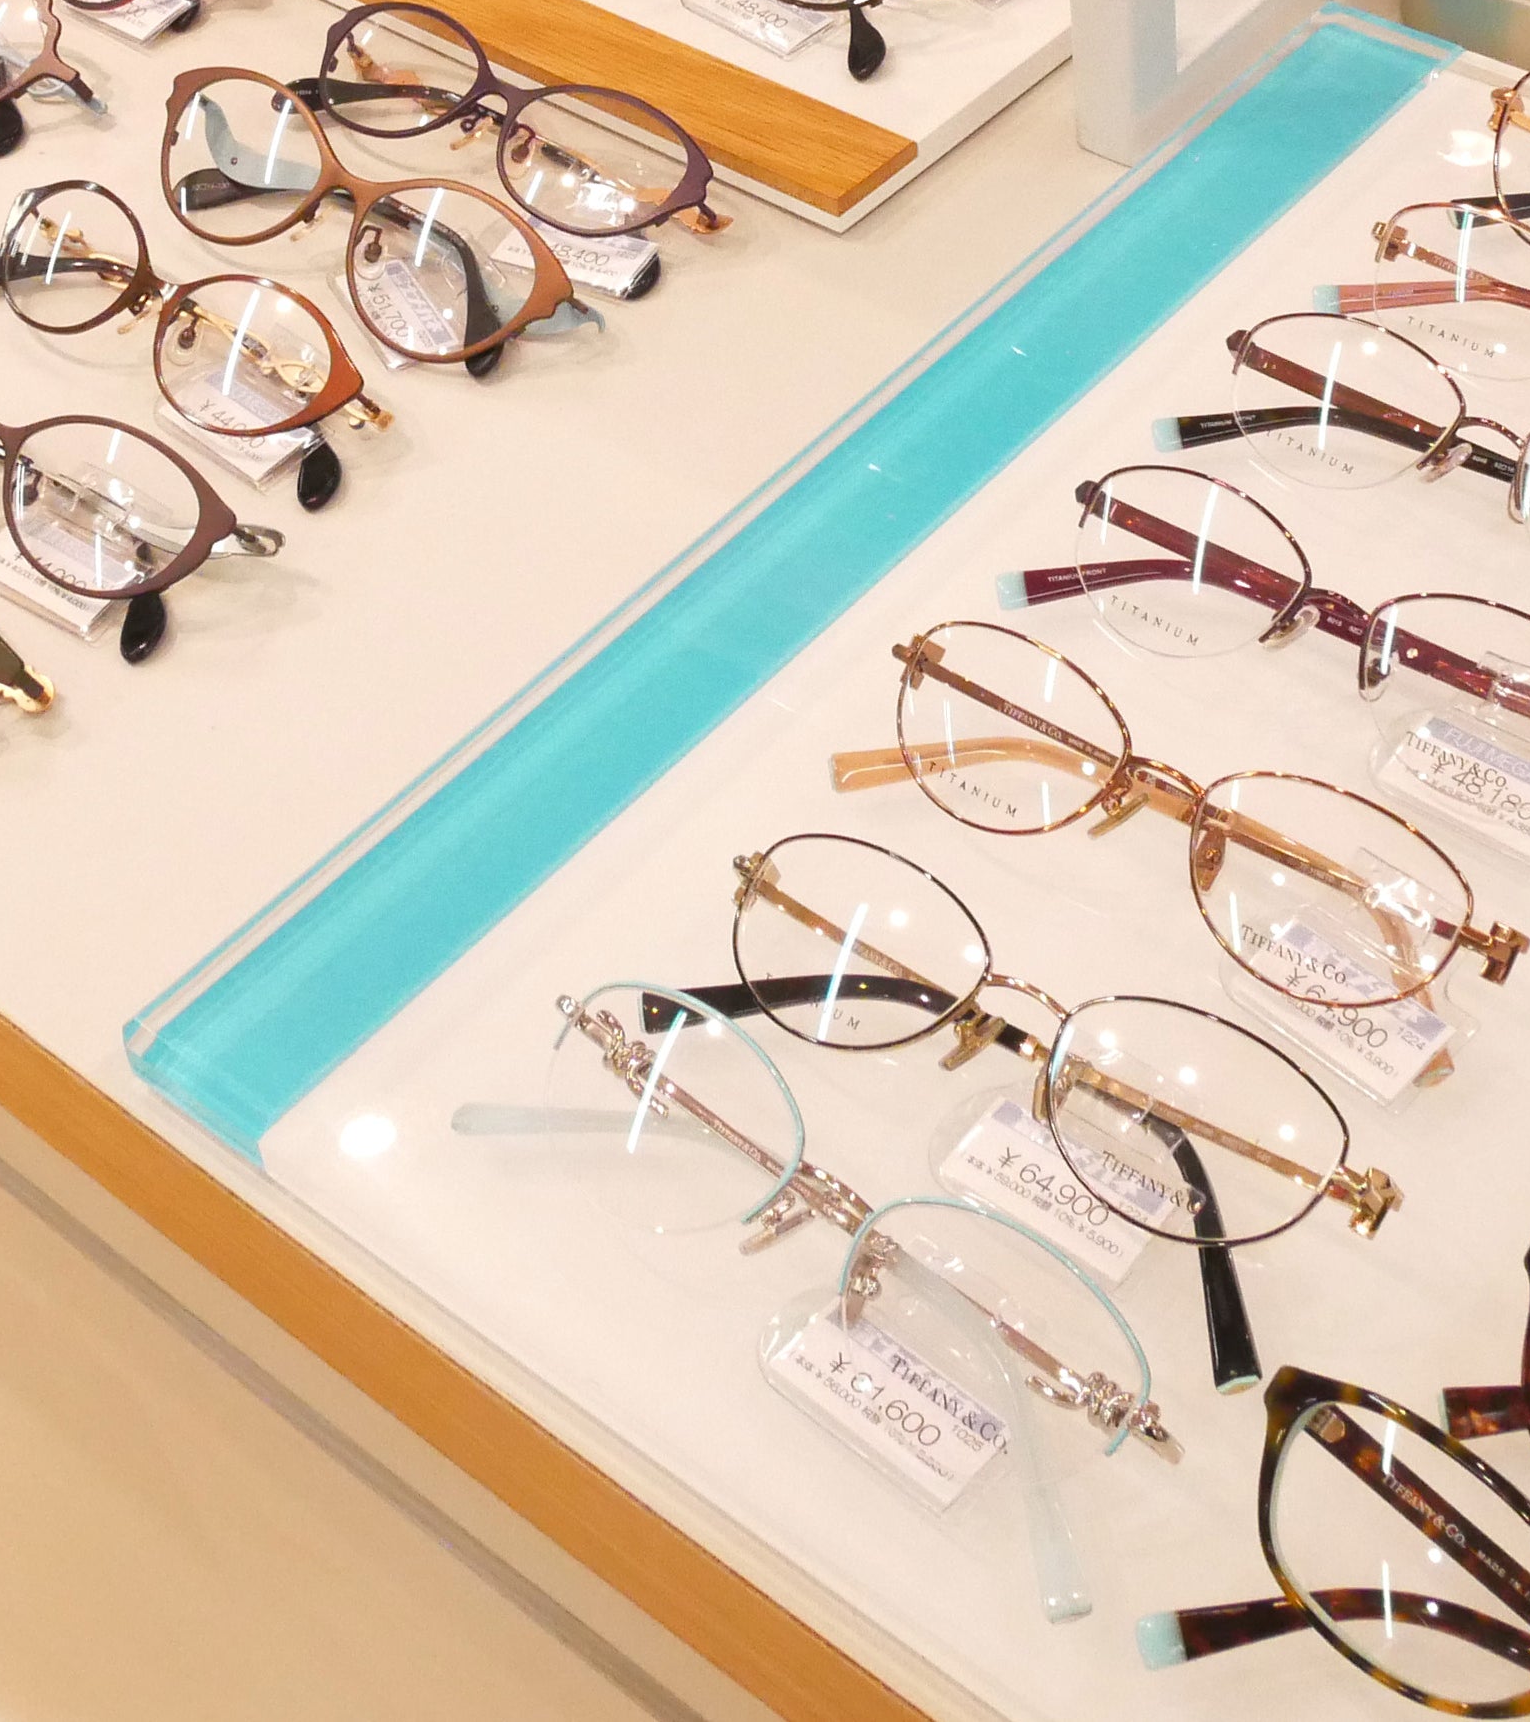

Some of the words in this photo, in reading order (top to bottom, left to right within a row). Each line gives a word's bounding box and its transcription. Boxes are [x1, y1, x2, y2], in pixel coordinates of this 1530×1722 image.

[1407, 315, 1496, 359] TITANIUM
[1265, 428, 1355, 475] TITANIUM
[1109, 593, 1201, 648] TITANIUM
[1405, 730, 1468, 771] TIFFANY
[928, 761, 1018, 819] TITANIUM
[1241, 923, 1303, 968] TIFFANY
[1102, 1149, 1169, 1200] TIFFANY
[890, 1352, 964, 1419] TIFFANY
